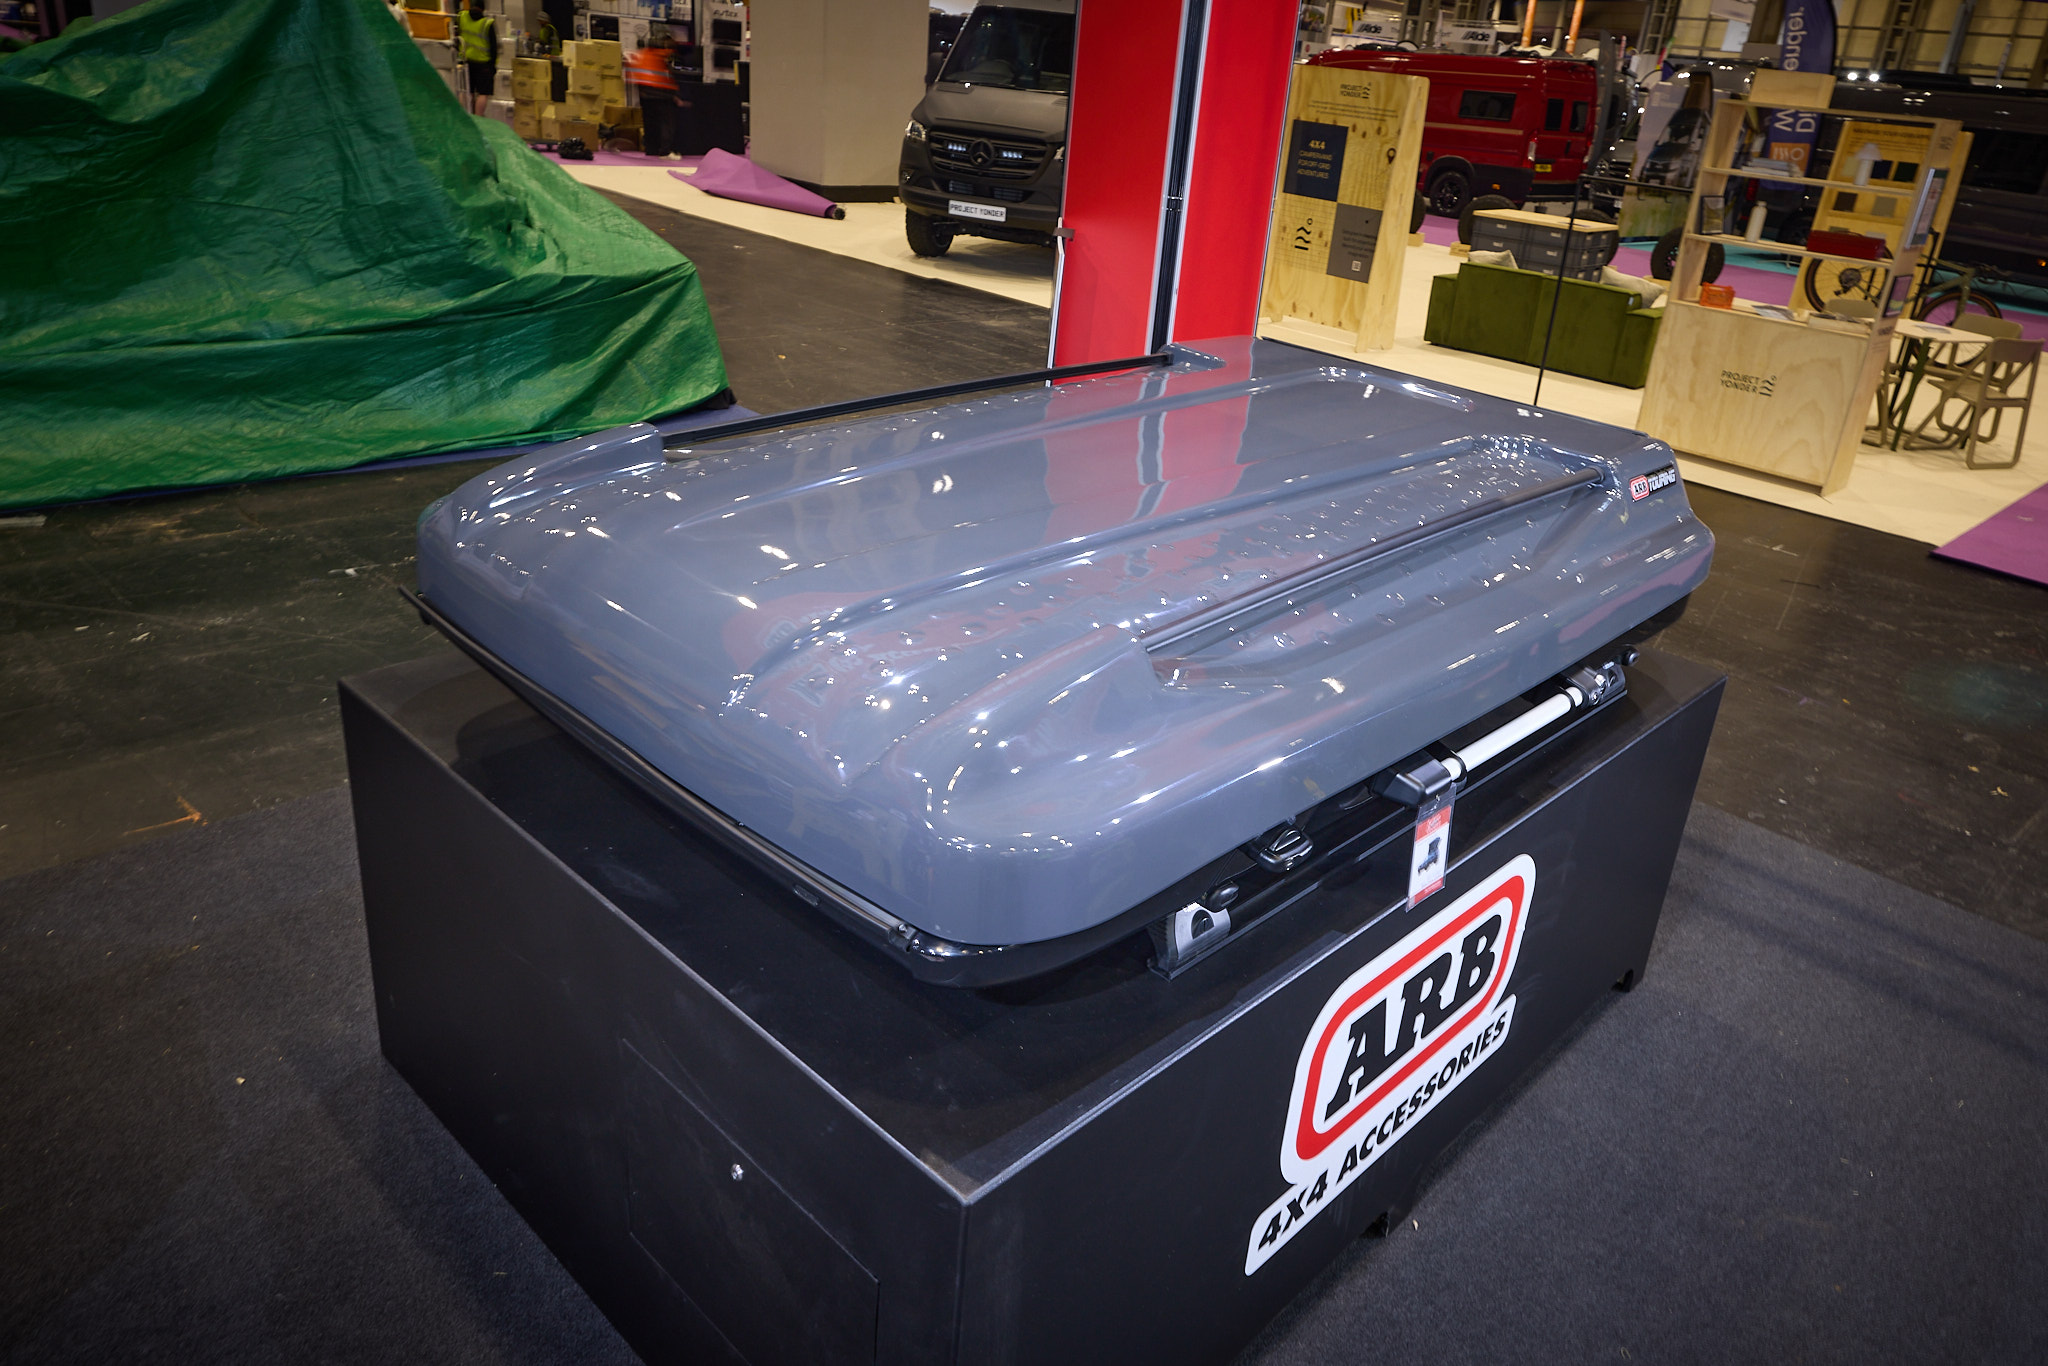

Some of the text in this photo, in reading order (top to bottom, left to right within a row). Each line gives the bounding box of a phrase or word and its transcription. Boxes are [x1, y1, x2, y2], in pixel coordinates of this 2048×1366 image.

[950, 203, 1004, 218] PROJECT YONDER
[1721, 370, 1760, 384] PROJECT
[1720, 379, 1757, 393] YONDER
[1633, 481, 1647, 496] ARB
[1324, 915, 1501, 1122] ARB
[1258, 1011, 1506, 1250] 4X4 ACCESSORIES
